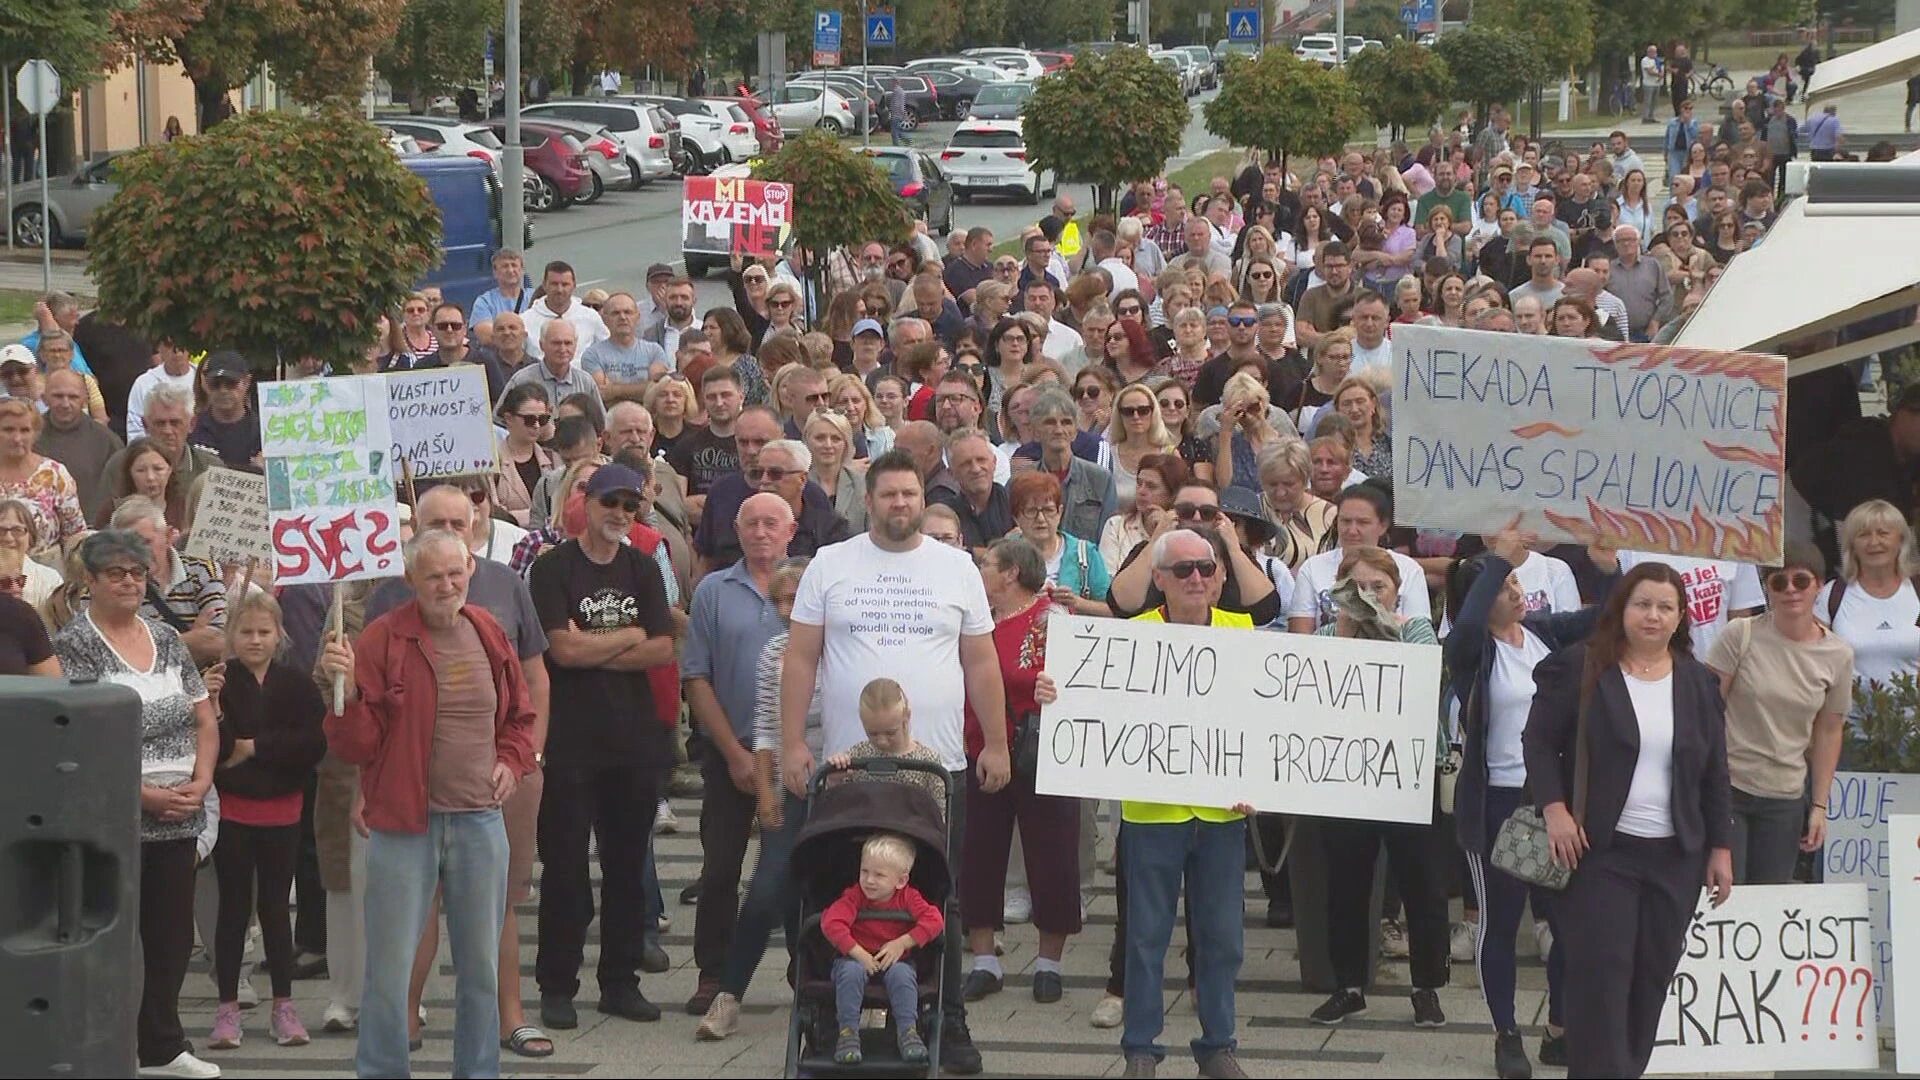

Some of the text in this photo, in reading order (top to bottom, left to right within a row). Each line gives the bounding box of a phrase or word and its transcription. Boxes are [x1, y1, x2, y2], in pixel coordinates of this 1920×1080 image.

[715, 177, 745, 201] MI
[766, 189, 785, 198] STOP
[390, 379, 460, 401] VLASTITU
[1404, 349, 1554, 411] NEKADA
[390, 400, 466, 420] OVORNOST
[1574, 365, 1779, 431] TVORNICE
[408, 432, 455, 461] NAŠU
[415, 459, 465, 478] DJECU
[1405, 435, 1524, 492] DANAS
[1535, 448, 1777, 516] SPALIONICE
[272, 510, 397, 581] SVE?
[854, 586, 933, 597] nismo naslijedili
[876, 574, 911, 585] Zemlju
[844, 598, 858, 607] od
[860, 598, 890, 609] svojih
[861, 611, 924, 622] nego smo je
[850, 623, 934, 636] posudili od svoje
[877, 636, 907, 647] djece!
[1065, 624, 1405, 716] ŽELIMO SPAVATI
[1052, 718, 1244, 777] OTVORENIH
[1827, 838, 1890, 878] GORE
[1683, 910, 1762, 962] ŠTO
[1779, 908, 1869, 962] ČIST
[1796, 963, 1873, 1042] ???
